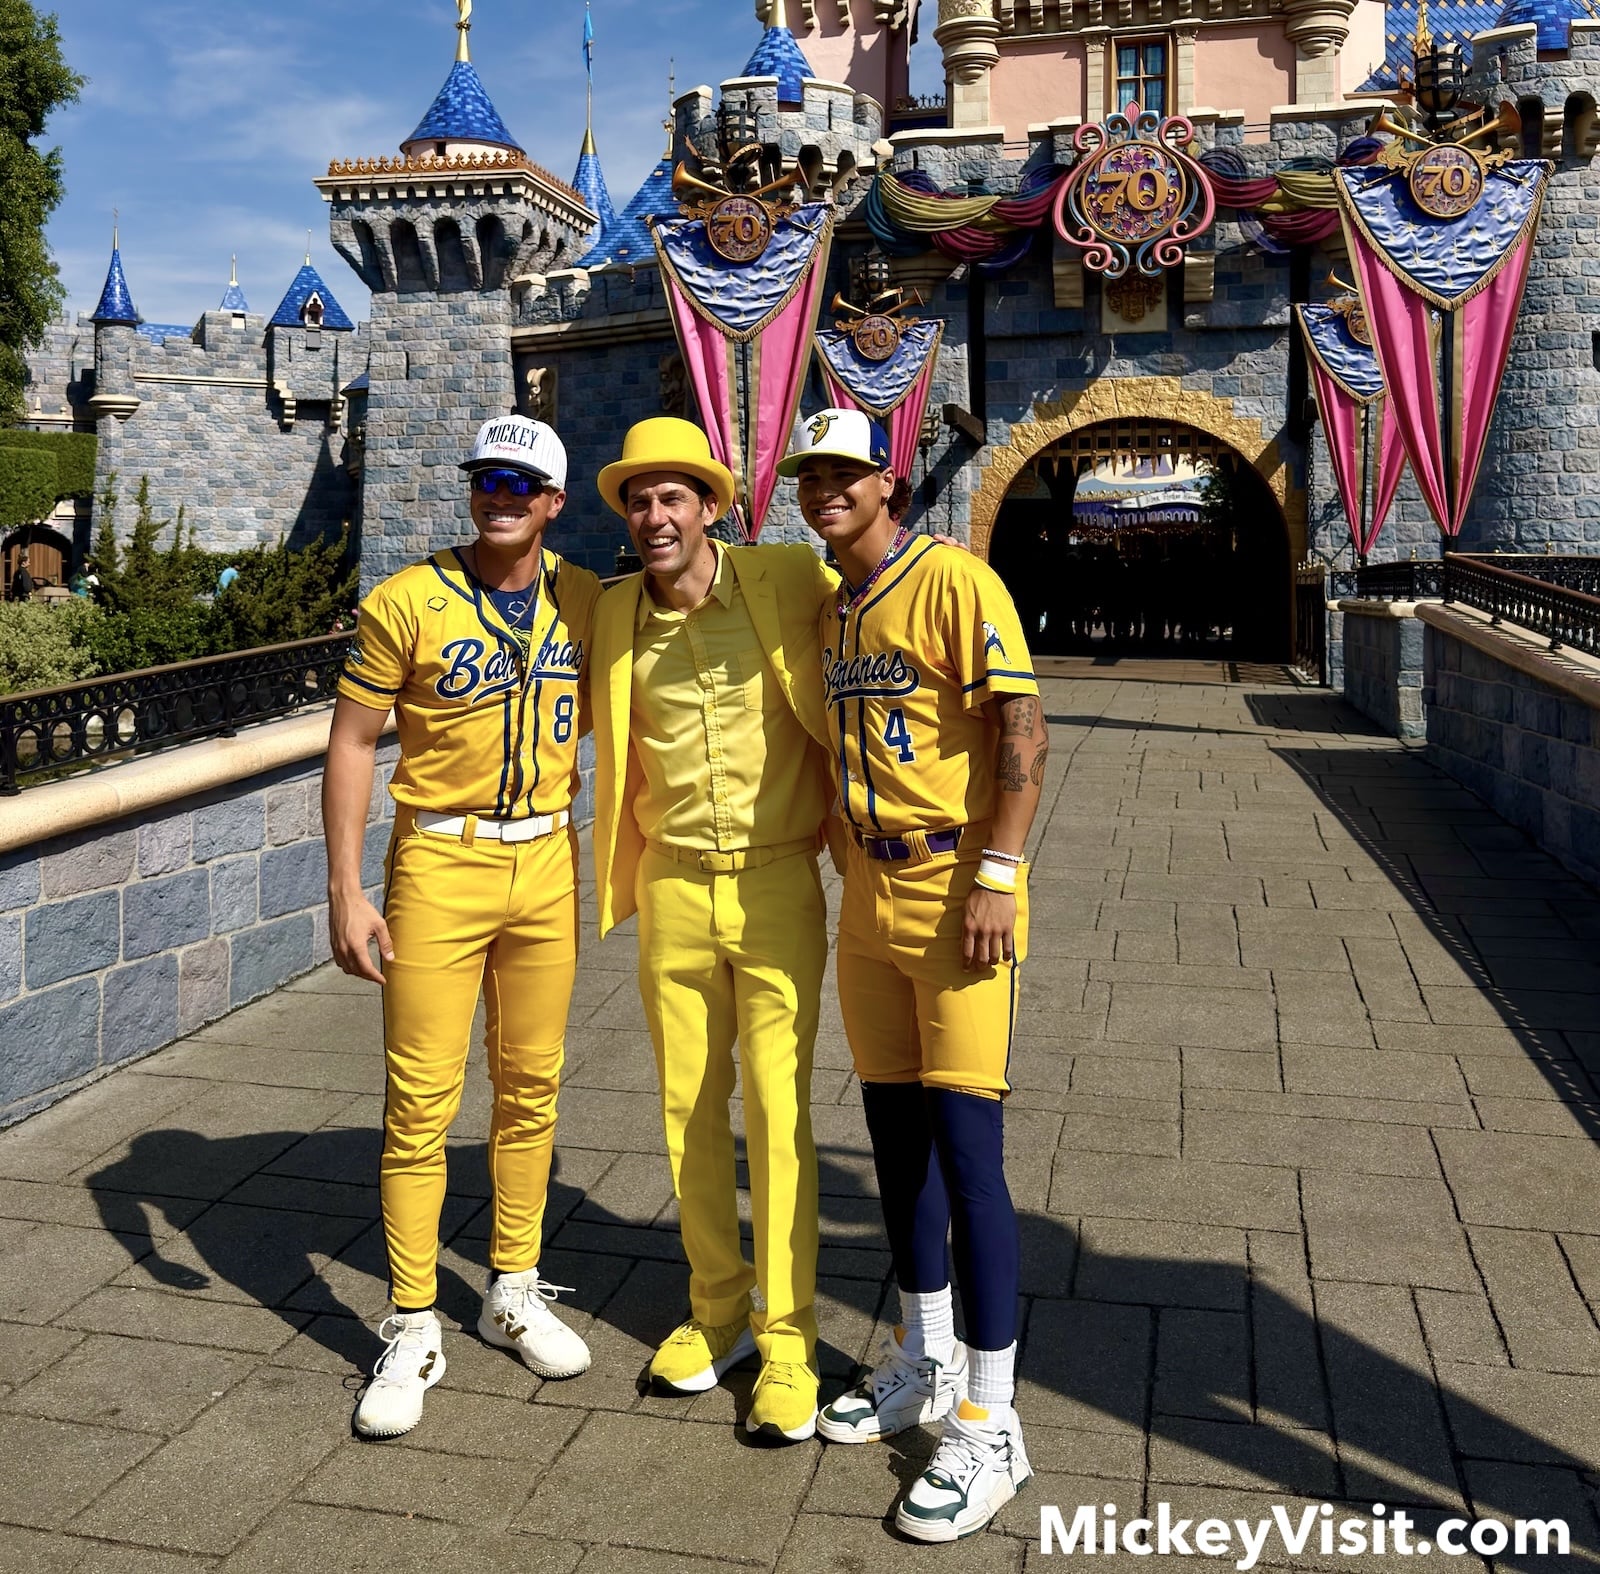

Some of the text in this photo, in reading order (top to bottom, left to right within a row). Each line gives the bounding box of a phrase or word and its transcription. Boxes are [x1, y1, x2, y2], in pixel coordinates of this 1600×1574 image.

[1098, 169, 1169, 214] 70
[1421, 165, 1473, 197] 70
[717, 214, 762, 243] 70
[861, 327, 893, 349] 70
[484, 423, 540, 450] MICKEY
[434, 637, 584, 701] Bannas
[552, 694, 574, 744] 8
[883, 707, 918, 765] 4
